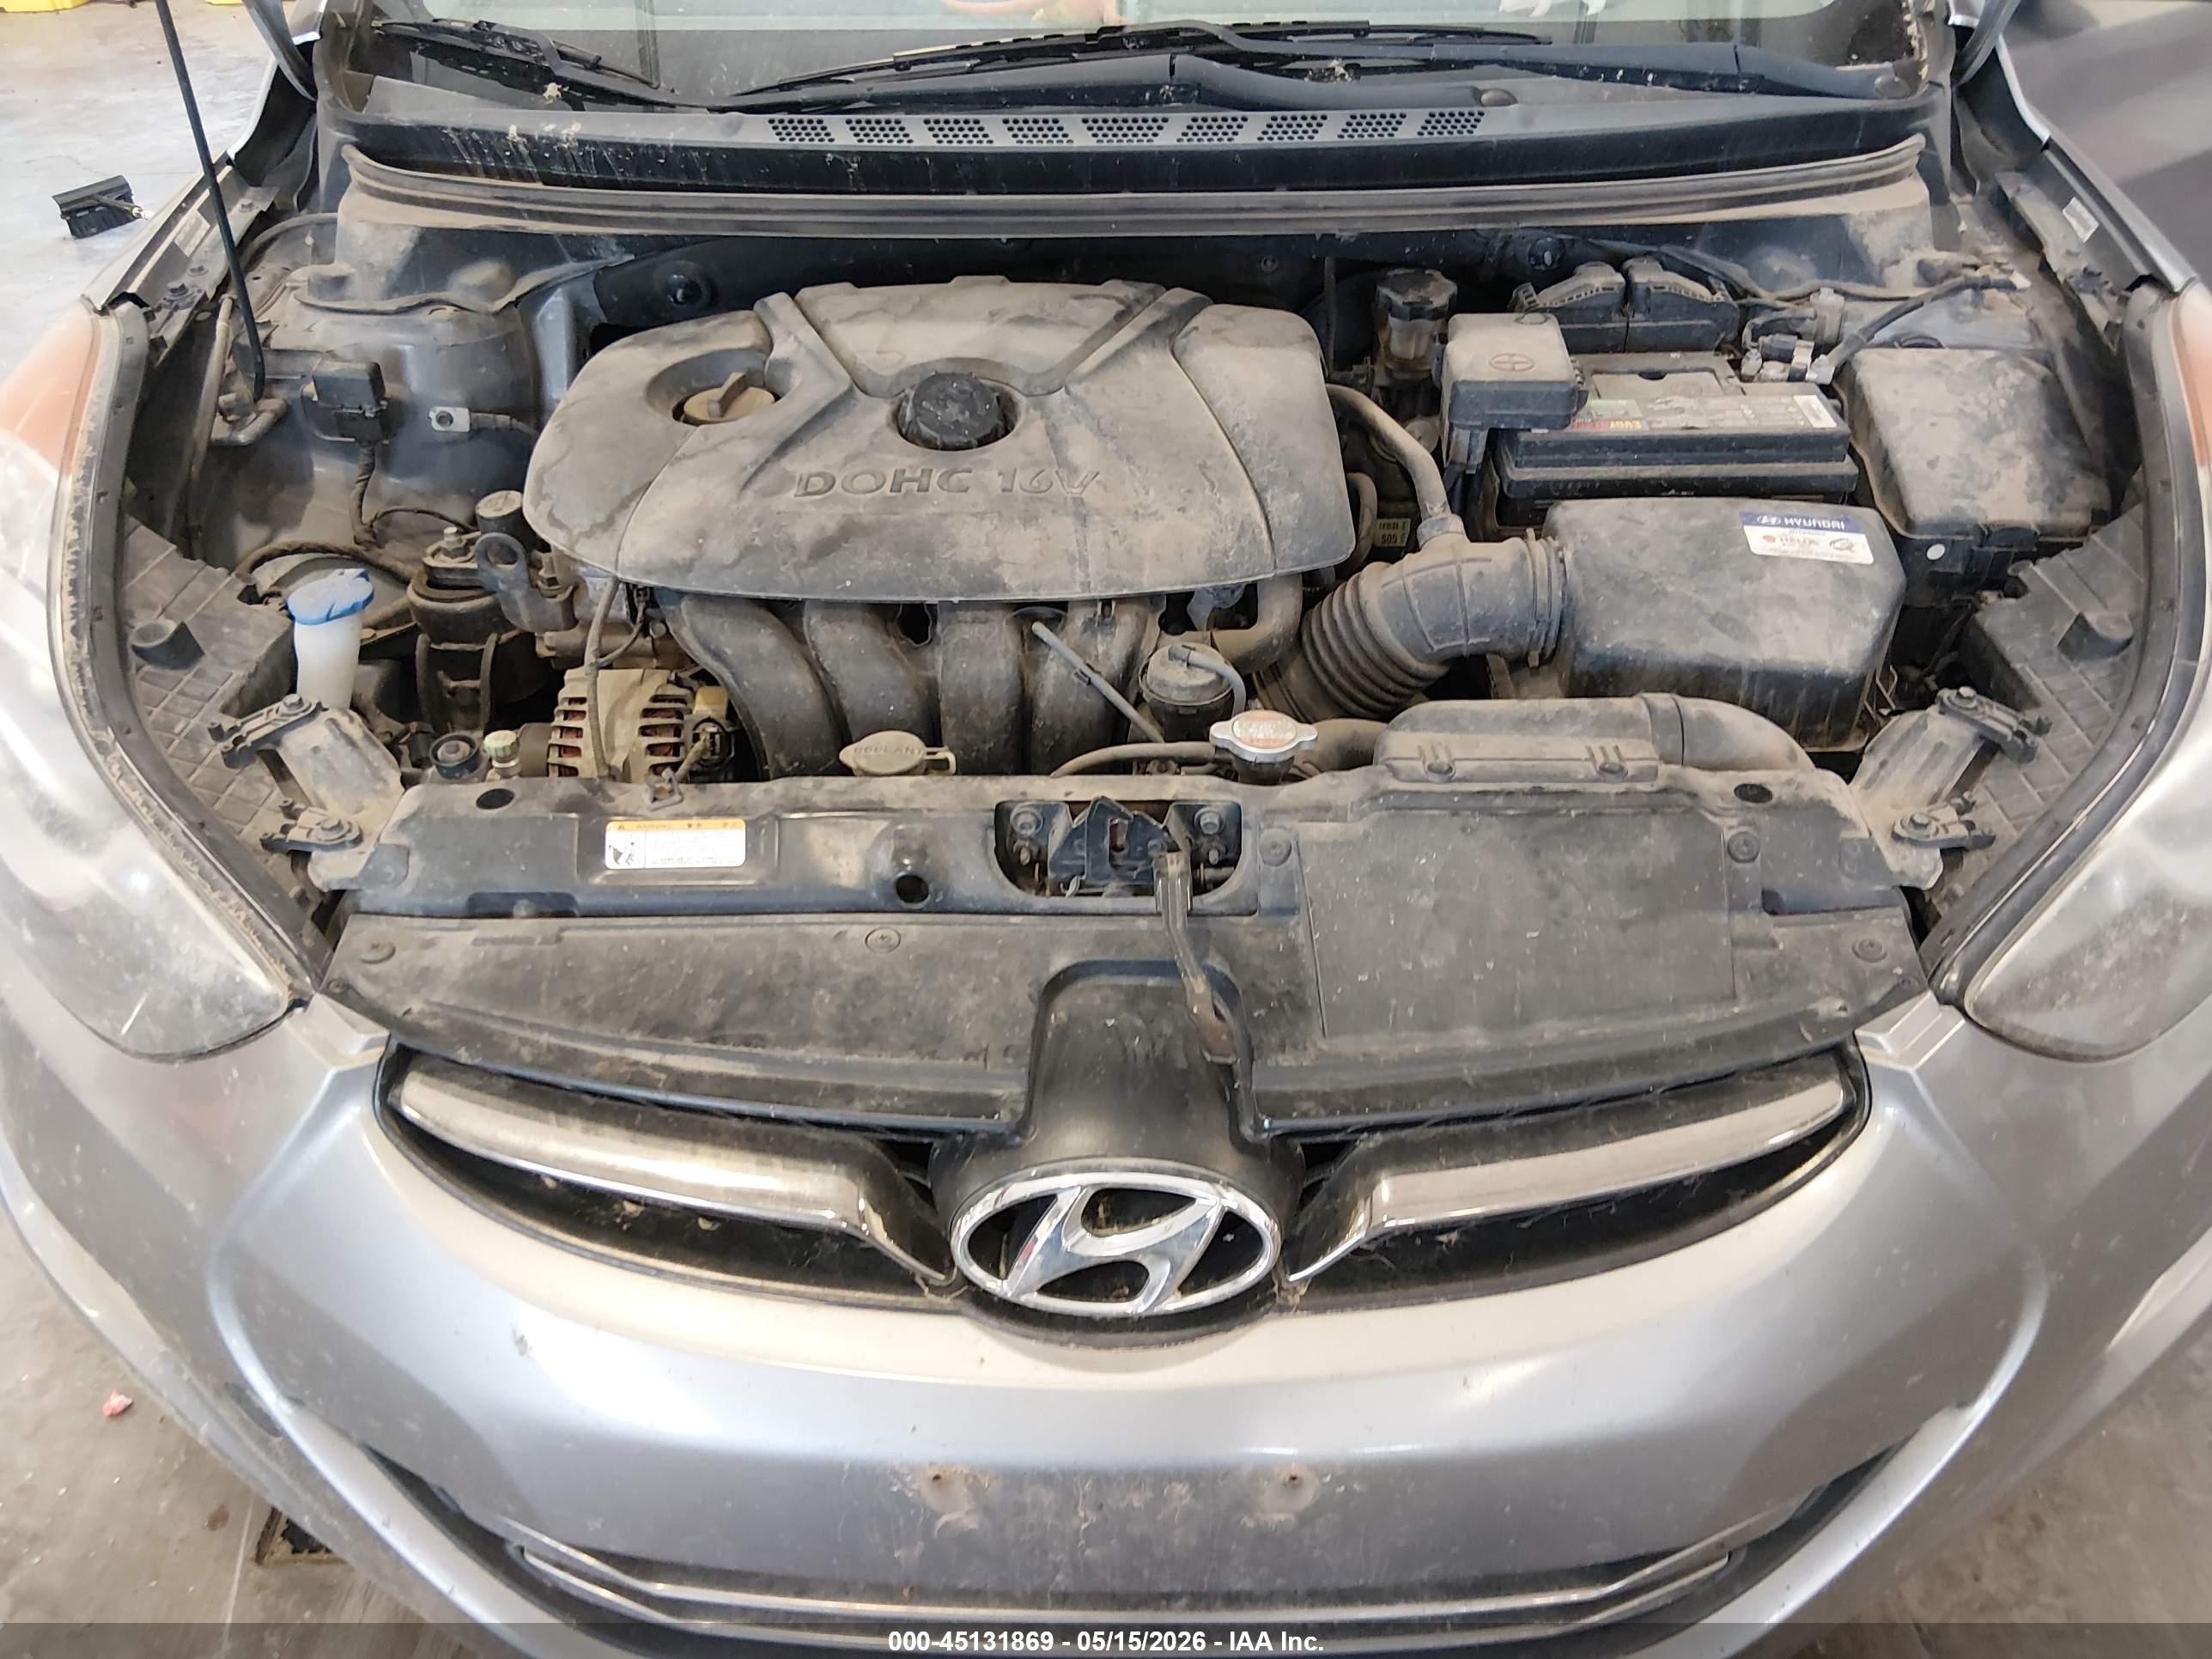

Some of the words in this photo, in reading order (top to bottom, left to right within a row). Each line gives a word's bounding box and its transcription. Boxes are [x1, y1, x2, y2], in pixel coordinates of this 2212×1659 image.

[794, 467, 972, 498] DOHC
[997, 466, 1100, 495] 16V
[1784, 517, 1845, 530] HYUNDAI
